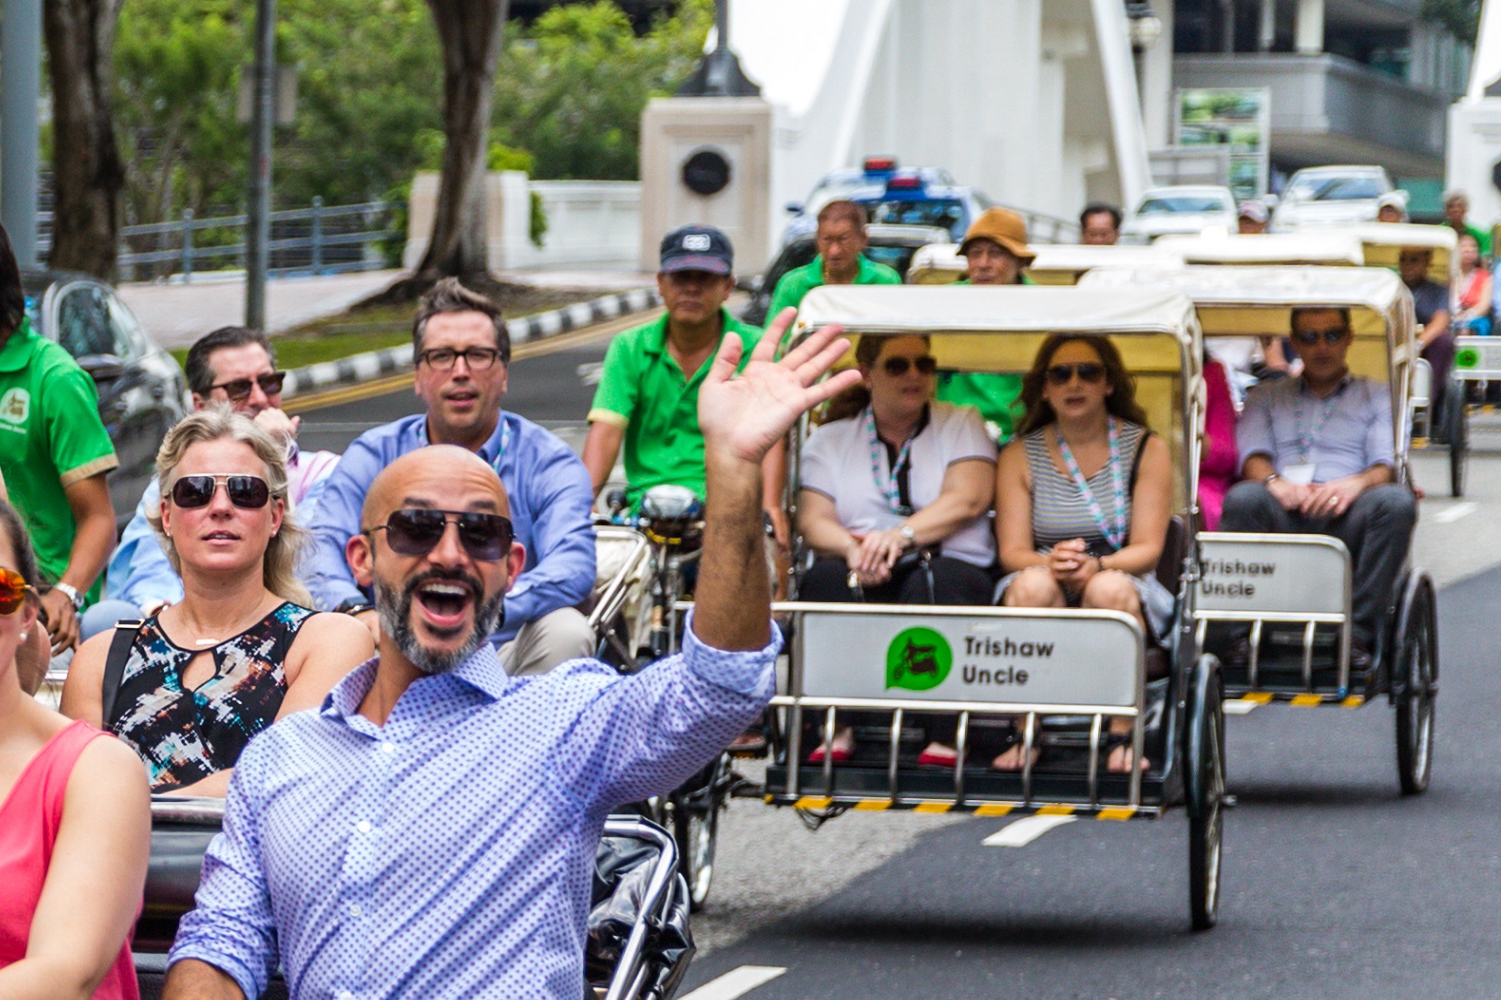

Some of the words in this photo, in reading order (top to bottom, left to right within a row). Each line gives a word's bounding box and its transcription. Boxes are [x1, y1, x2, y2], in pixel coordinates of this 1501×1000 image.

[1201, 558, 1276, 576] Trishaw
[1202, 580, 1256, 596] Uncle
[963, 634, 1054, 657] Trishaw
[962, 665, 1028, 685] Uncle
